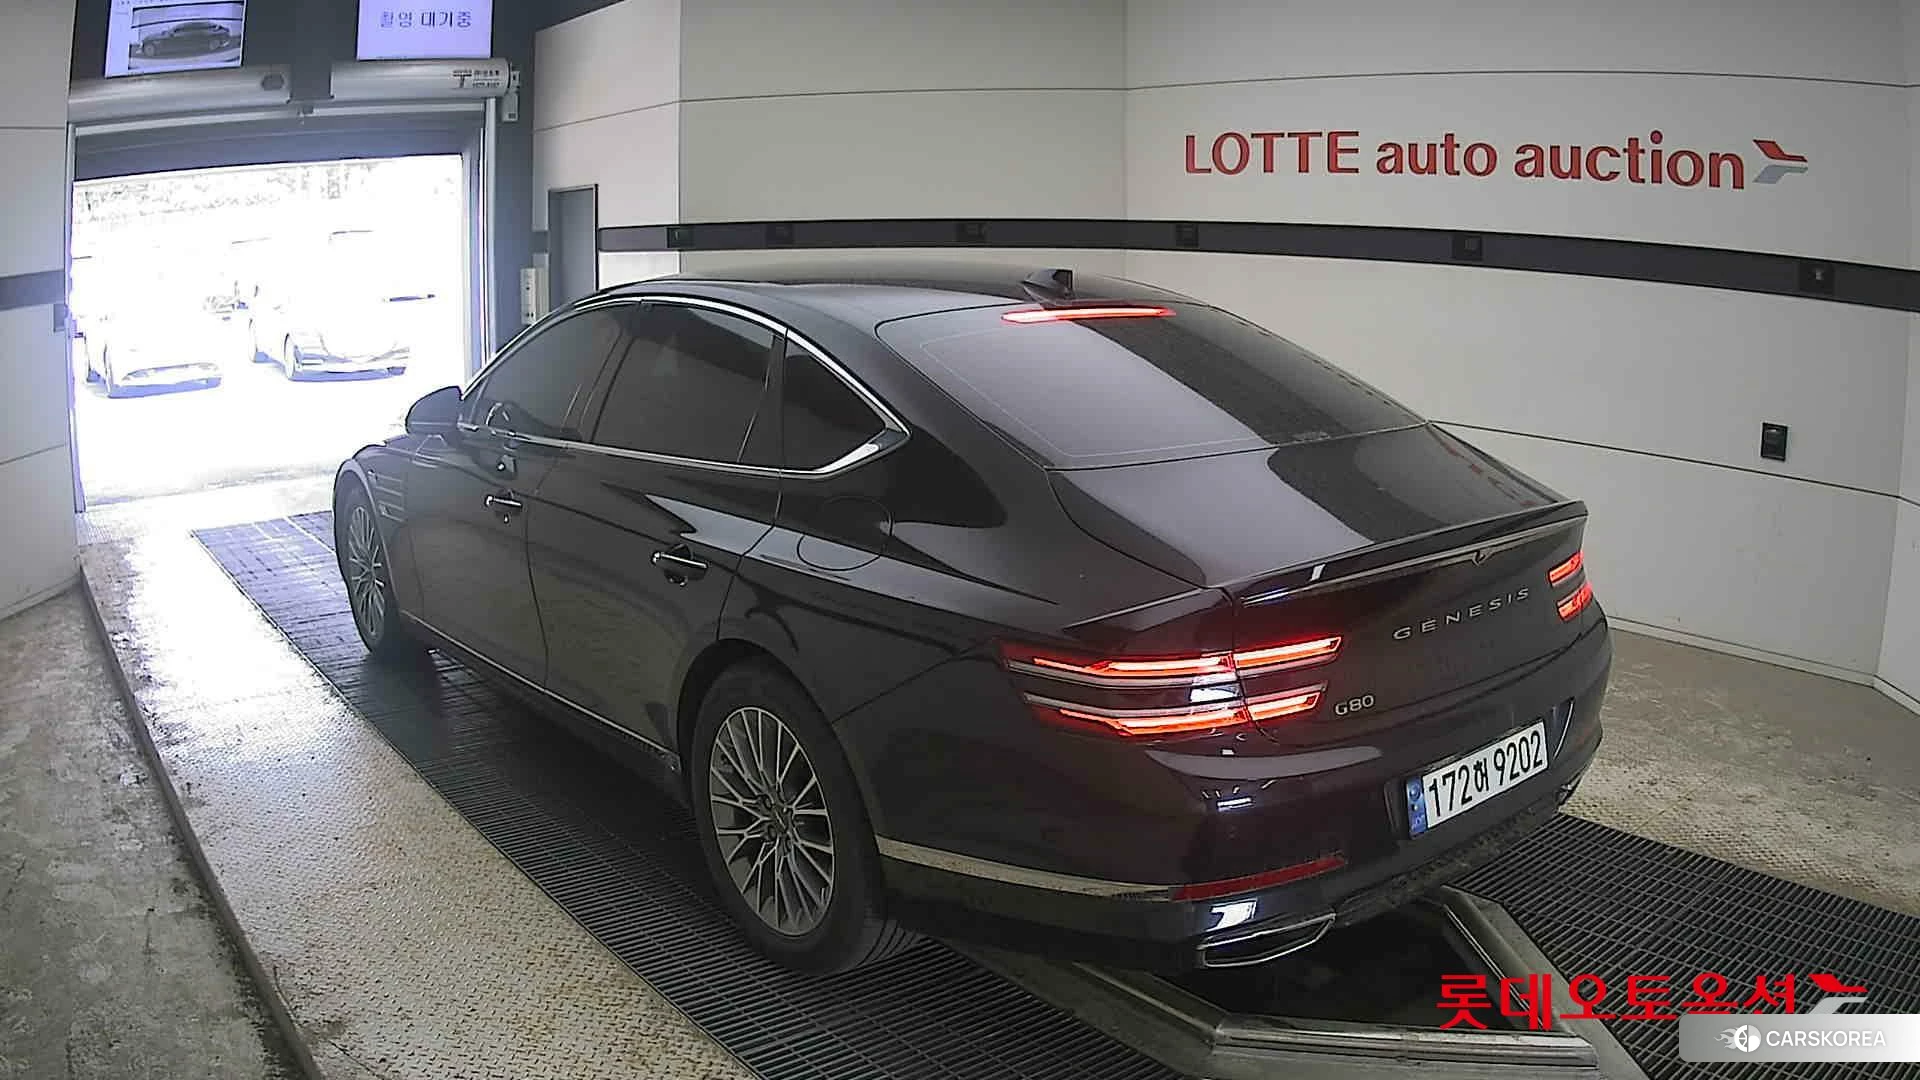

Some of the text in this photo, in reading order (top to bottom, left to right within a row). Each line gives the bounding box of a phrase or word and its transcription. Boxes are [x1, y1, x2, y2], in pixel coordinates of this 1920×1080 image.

[421, 11, 471, 28] 대기중
[1185, 130, 1745, 190] LOTTE auto auction
[1393, 588, 1530, 640] GENESIS
[1334, 694, 1375, 717] G80
[1428, 730, 1544, 817] 172허 9202
